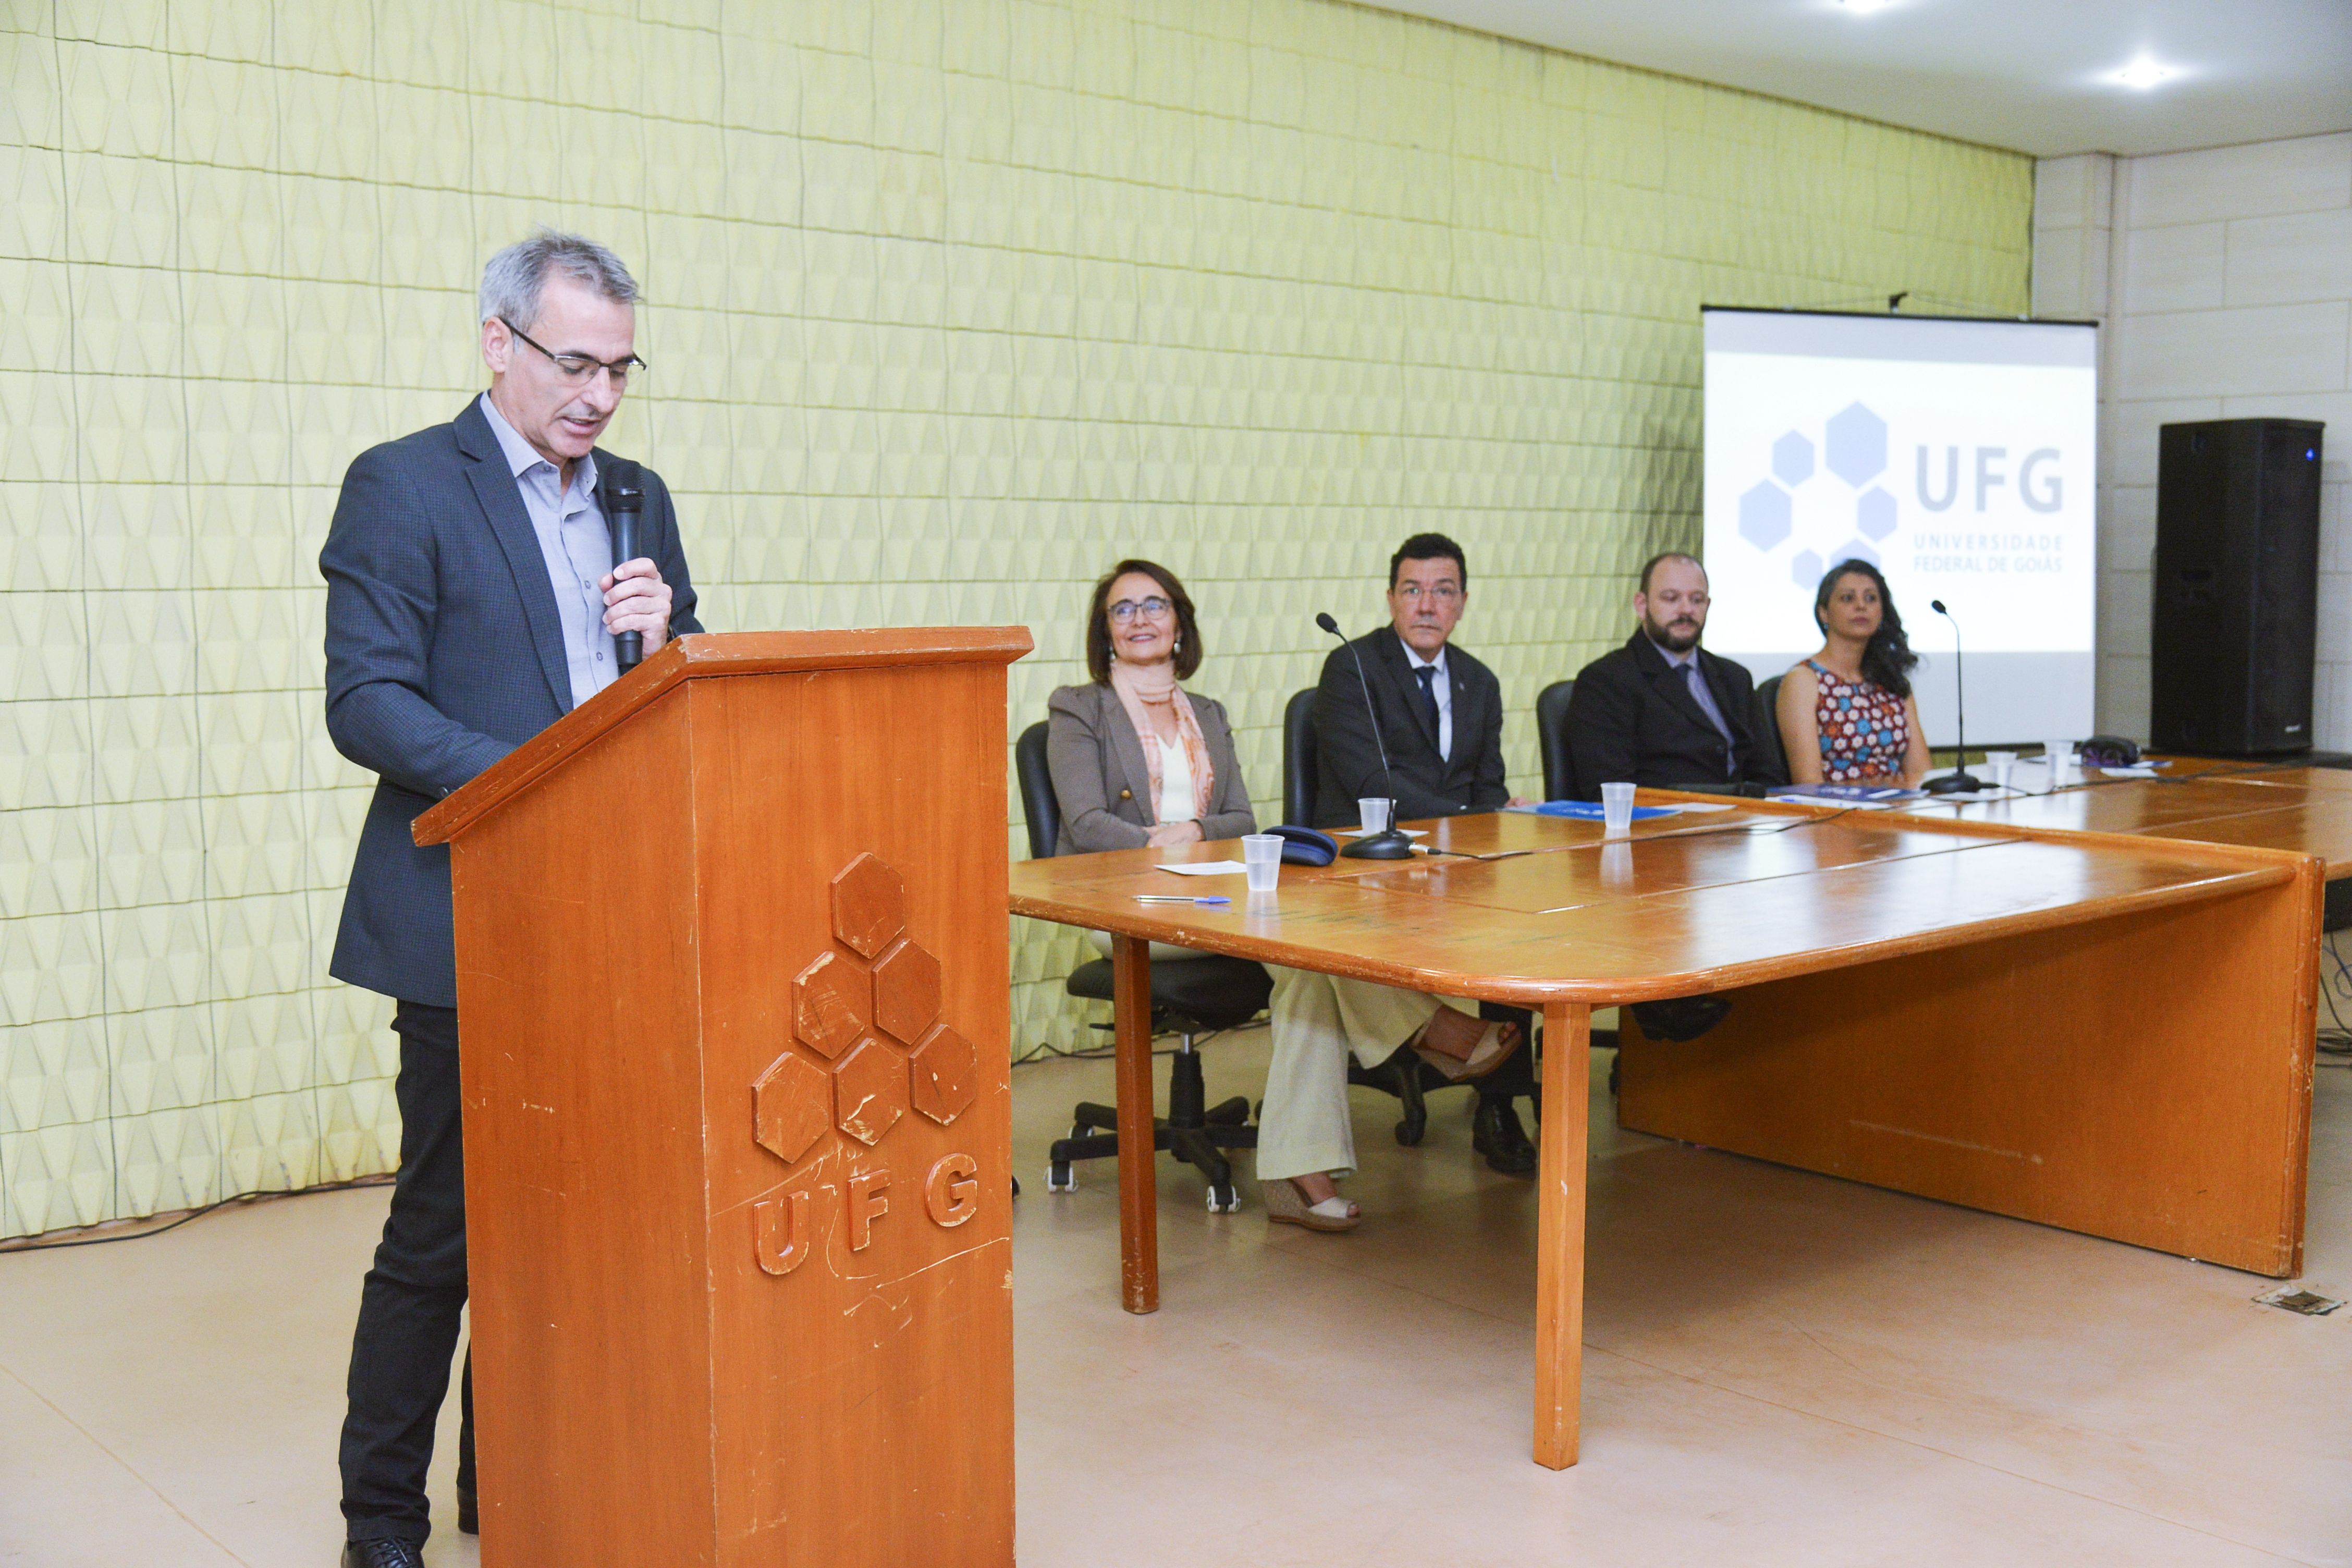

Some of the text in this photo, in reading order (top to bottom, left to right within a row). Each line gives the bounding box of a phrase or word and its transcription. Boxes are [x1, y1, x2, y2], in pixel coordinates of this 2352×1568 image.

[1915, 444, 2064, 514] UFG
[1914, 533, 2062, 552] UNIVERSIDADE
[1913, 554, 2063, 573] FEDERAL DE GOIÁS
